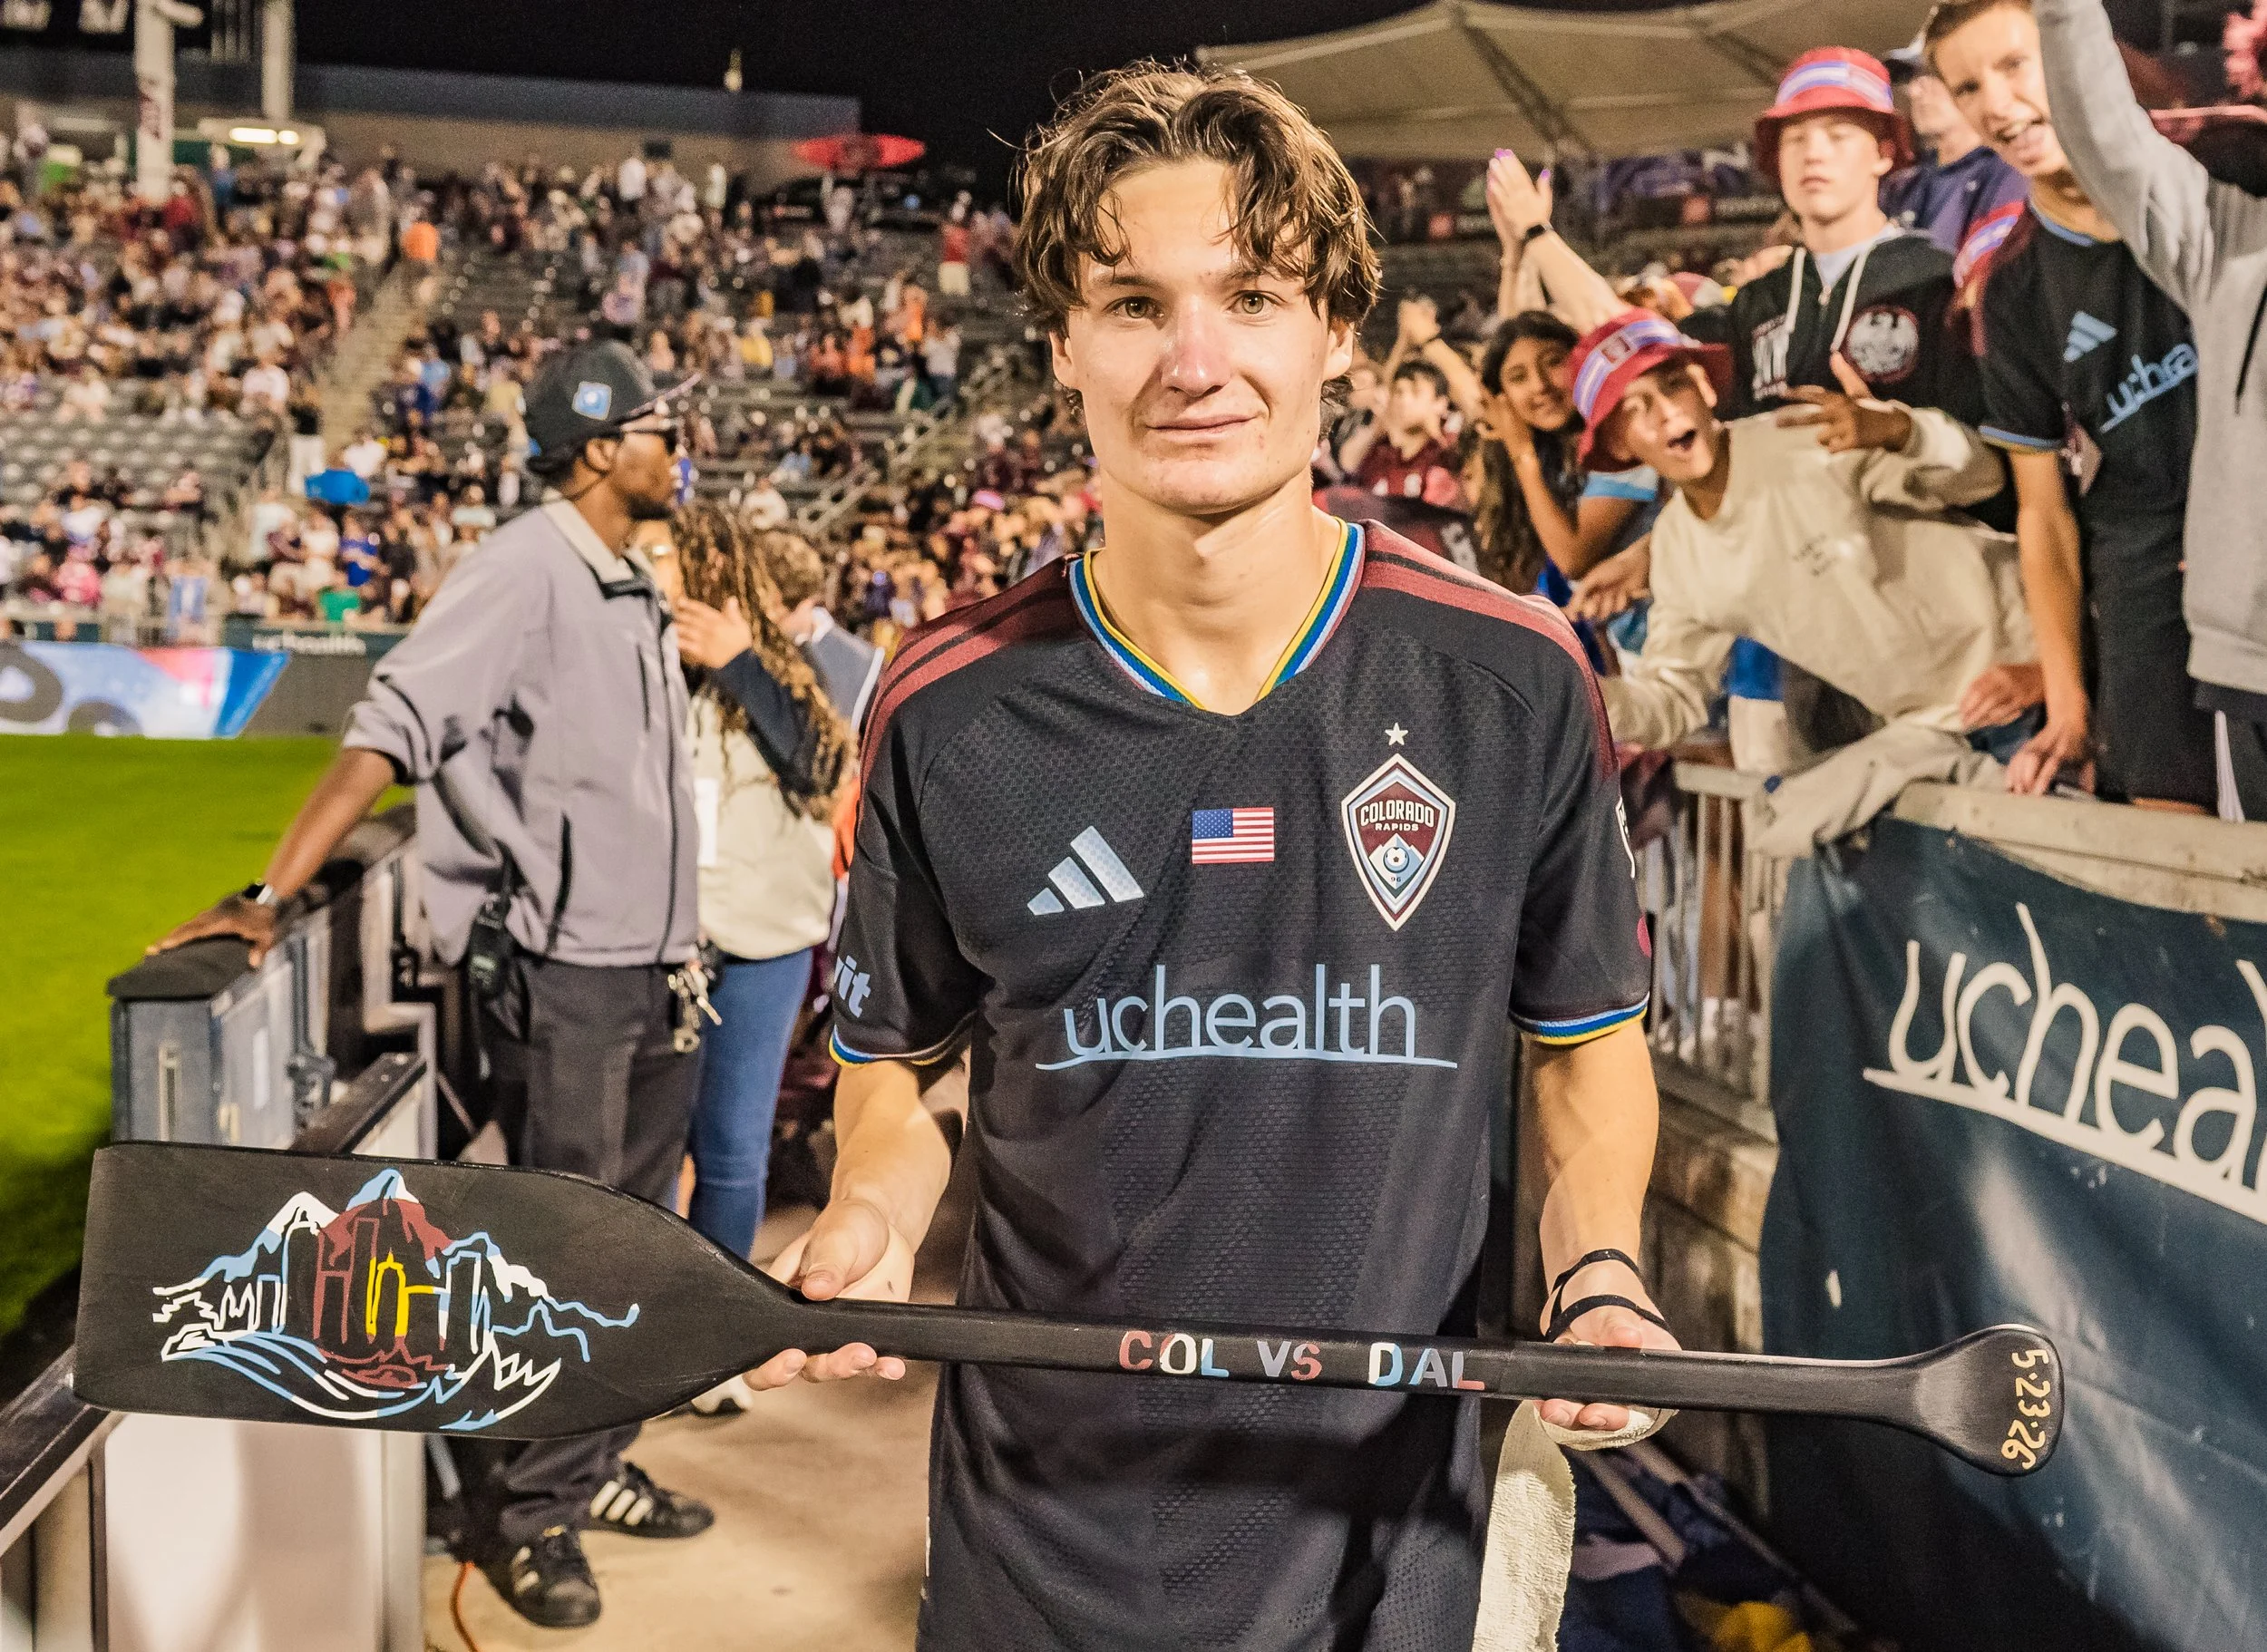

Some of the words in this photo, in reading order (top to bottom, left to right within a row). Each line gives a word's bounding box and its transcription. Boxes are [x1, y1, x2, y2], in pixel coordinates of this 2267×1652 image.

[1360, 799, 1435, 828] COLORADO
[1375, 822, 1419, 831] RAPIDS
[1062, 963, 1416, 1064] uchealth
[1119, 1330, 1230, 1378] COL
[1257, 1340, 1323, 1381] VS
[1367, 1342, 1485, 1391] DAL
